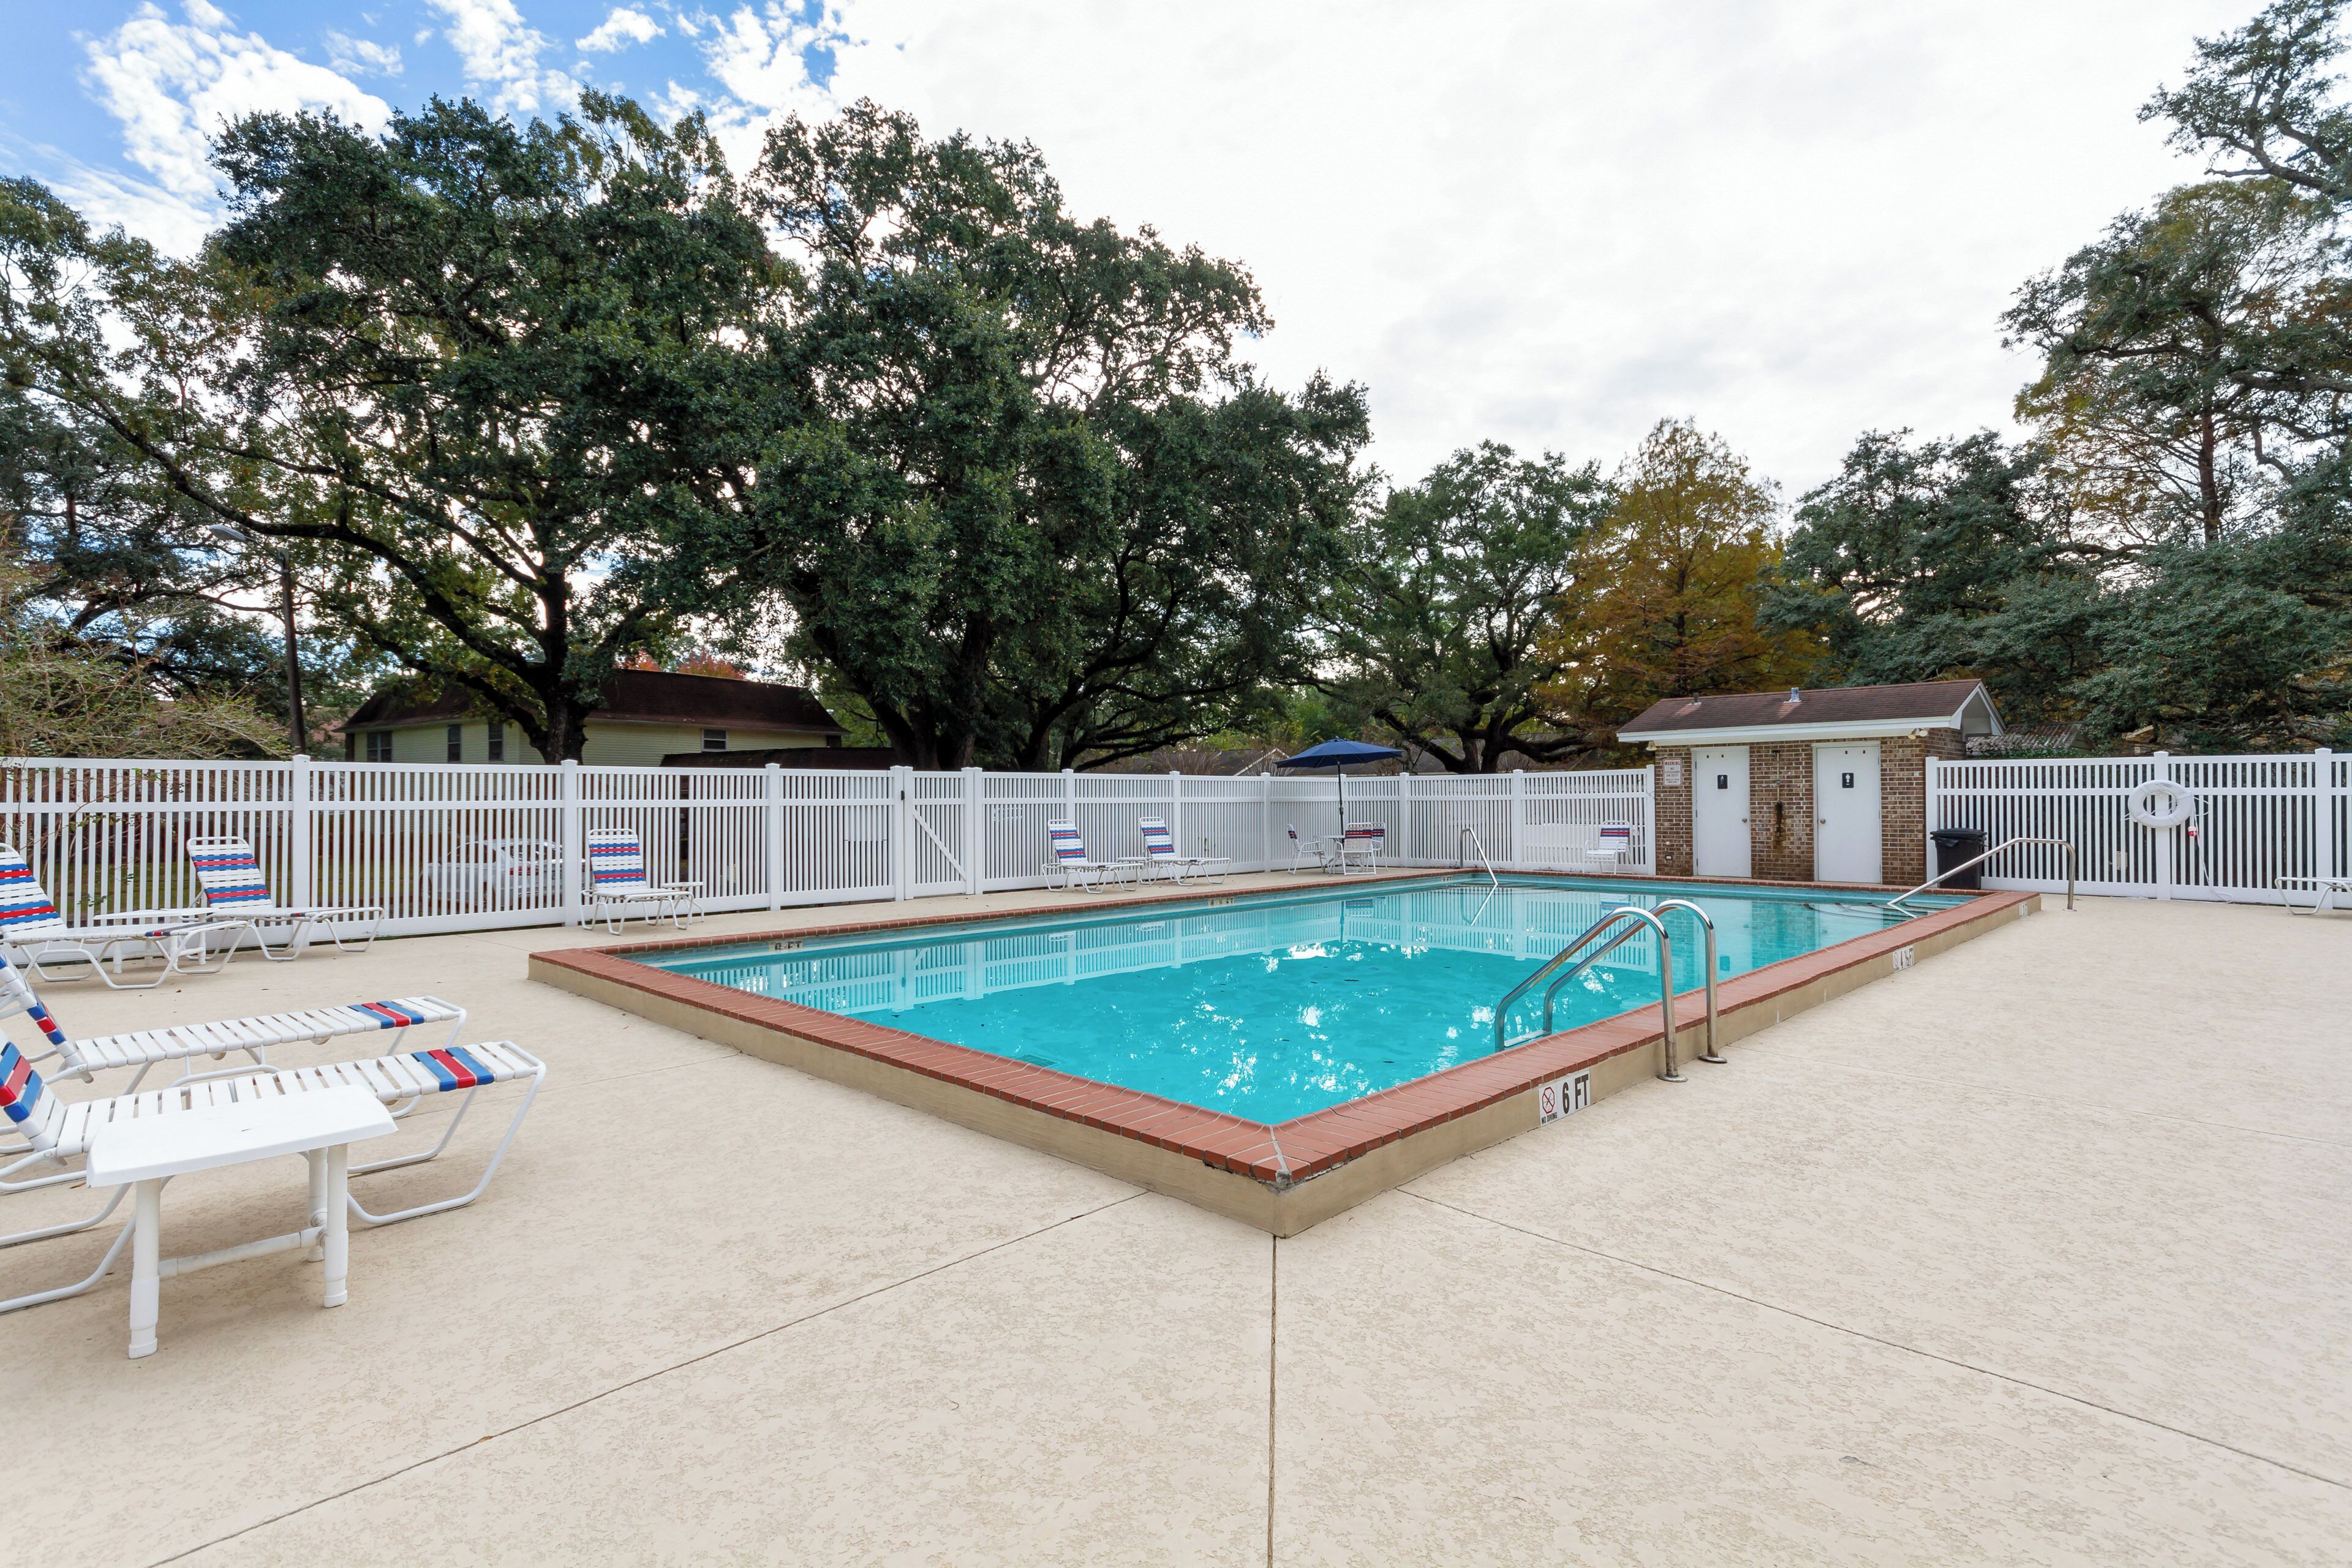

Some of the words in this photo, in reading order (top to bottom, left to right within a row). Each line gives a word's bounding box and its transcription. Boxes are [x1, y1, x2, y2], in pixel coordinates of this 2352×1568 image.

[788, 940, 802, 949] FT
[1562, 1082, 1570, 1114] 6
[1574, 1073, 1589, 1110] FT
[1547, 1112, 1558, 1122] DIVING
